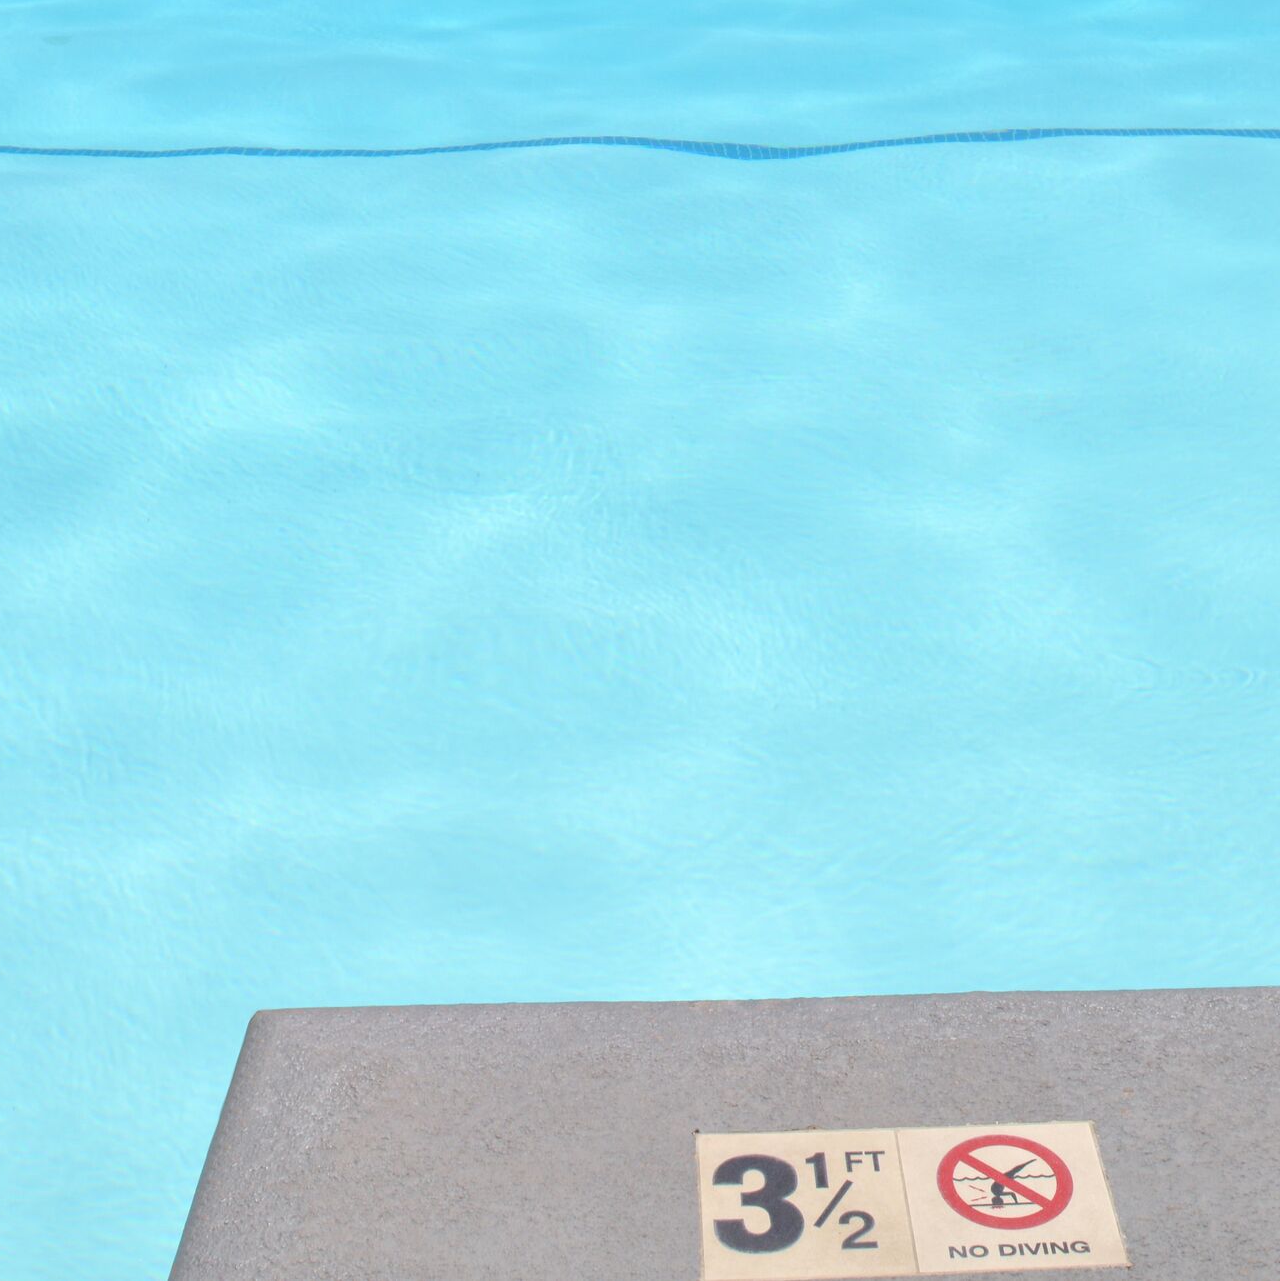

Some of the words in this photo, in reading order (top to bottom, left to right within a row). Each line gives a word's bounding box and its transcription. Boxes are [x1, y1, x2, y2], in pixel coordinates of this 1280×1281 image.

[844, 1150, 885, 1173] FT
[949, 1244, 989, 1259] NO
[998, 1240, 1091, 1258] DIVING
